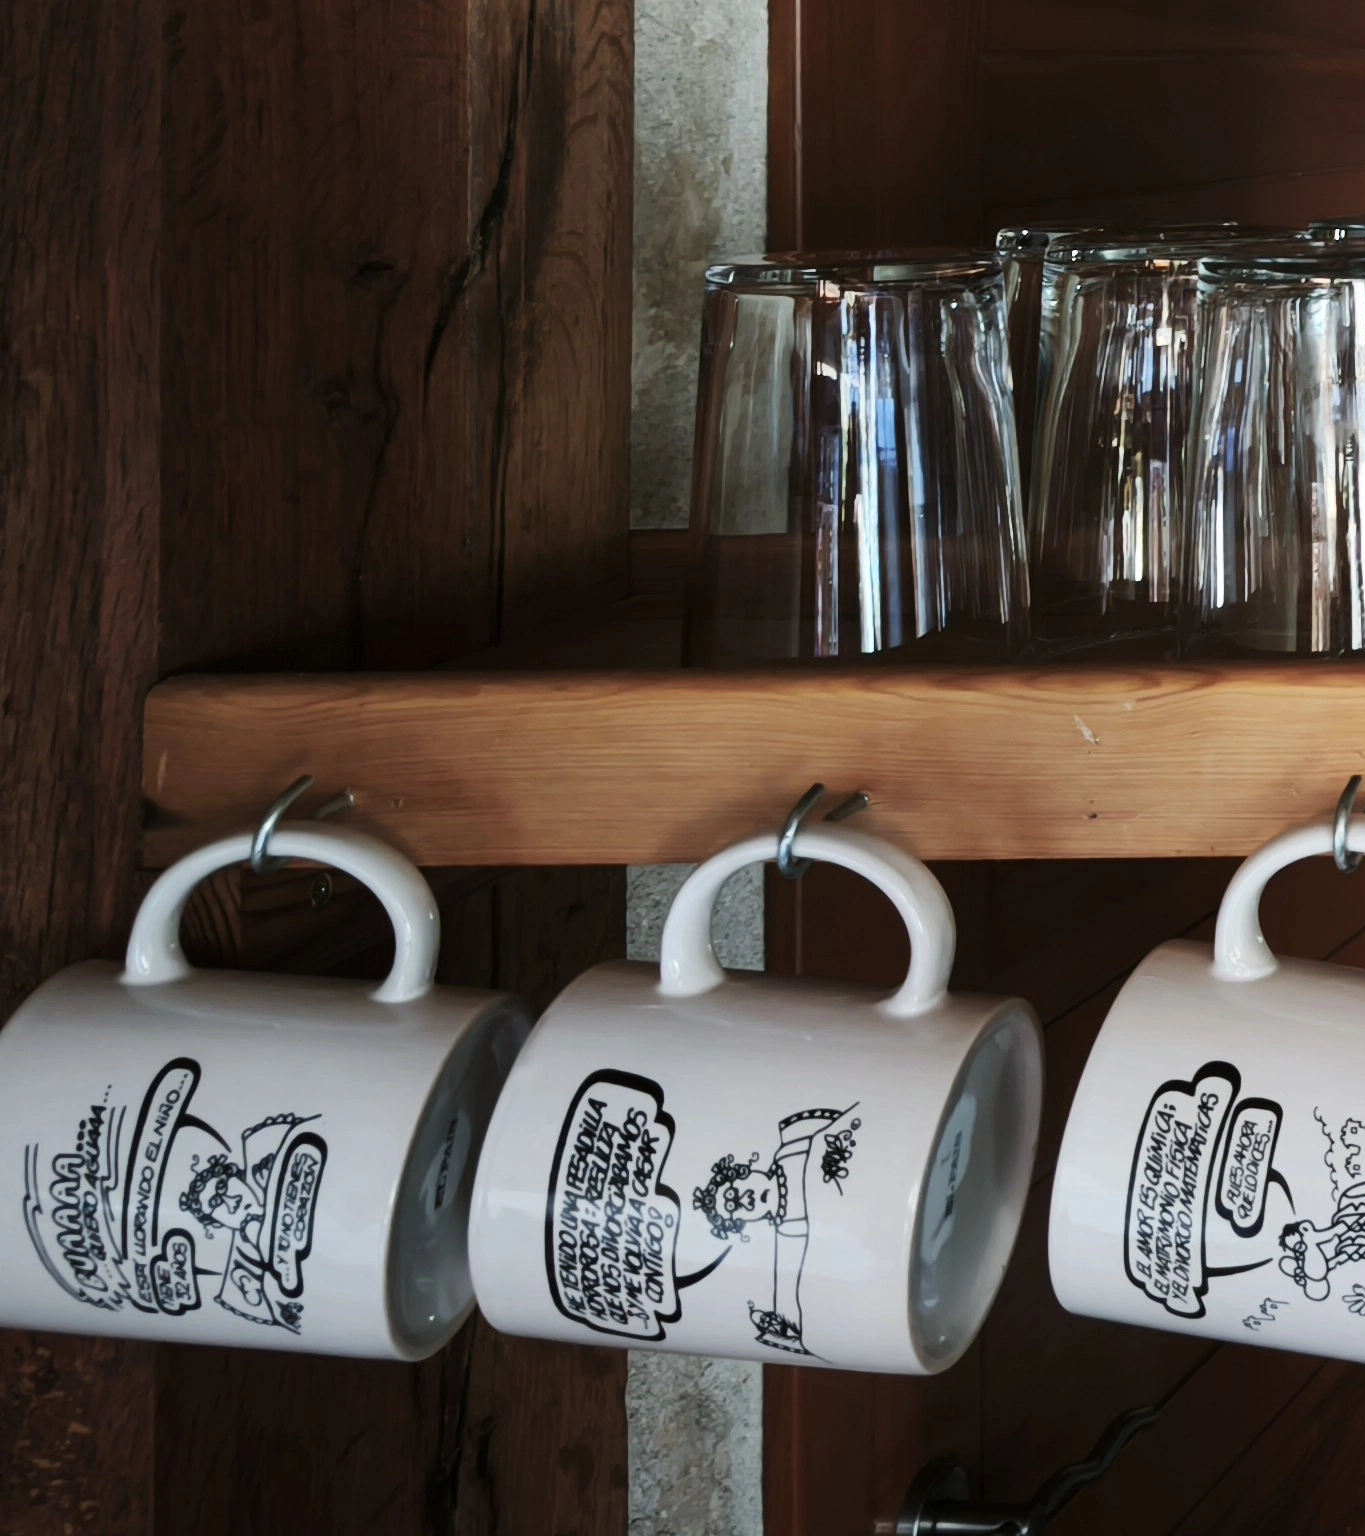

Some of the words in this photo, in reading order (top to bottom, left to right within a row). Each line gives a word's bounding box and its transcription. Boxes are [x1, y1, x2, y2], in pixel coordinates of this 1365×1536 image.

[152, 1073, 188, 1136] NIÑO...
[146, 1136, 164, 1162] EL
[566, 1098, 608, 1191] PESADILLA
[1144, 1103, 1176, 1186] QUÍMICA;
[1165, 1120, 1192, 1180] FÍSICA
[1234, 1120, 1258, 1166] AHORA
[1246, 1120, 1272, 1175] DICES...
[284, 1153, 306, 1212] TIENES
[585, 1121, 620, 1210] RESULTA
[632, 1129, 660, 1198] CASAR
[1244, 1174, 1257, 1192] LO
[1139, 1184, 1158, 1210] ES
[1226, 1166, 1244, 1205] PUES
[134, 1166, 154, 1256] LLORANDO
[280, 1213, 294, 1237] NO
[560, 1190, 585, 1230] UNA
[628, 1198, 646, 1218] A
[1238, 1192, 1255, 1220] QUE
[622, 1216, 643, 1275] VOLVÍA
[1137, 1208, 1154, 1261] AMOR
[1155, 1182, 1180, 1281] MATRIMONIO
[1173, 1210, 1192, 1282] DIVORCIO
[170, 1242, 186, 1280] AÑOS
[559, 1230, 580, 1291] TENIDO
[642, 1206, 674, 1304] CONTIGO!
[1136, 1260, 1152, 1278] EL
[158, 1266, 174, 1307] TIENE
[175, 1282, 191, 1300] 32
[600, 1263, 622, 1298] NOS
[623, 1275, 643, 1304] ME
[1154, 1279, 1170, 1296] EL
[1172, 1280, 1188, 1296] EL
[1172, 1291, 1187, 1304] Y
[564, 1291, 586, 1315] HE
[604, 1296, 628, 1324] QUE
